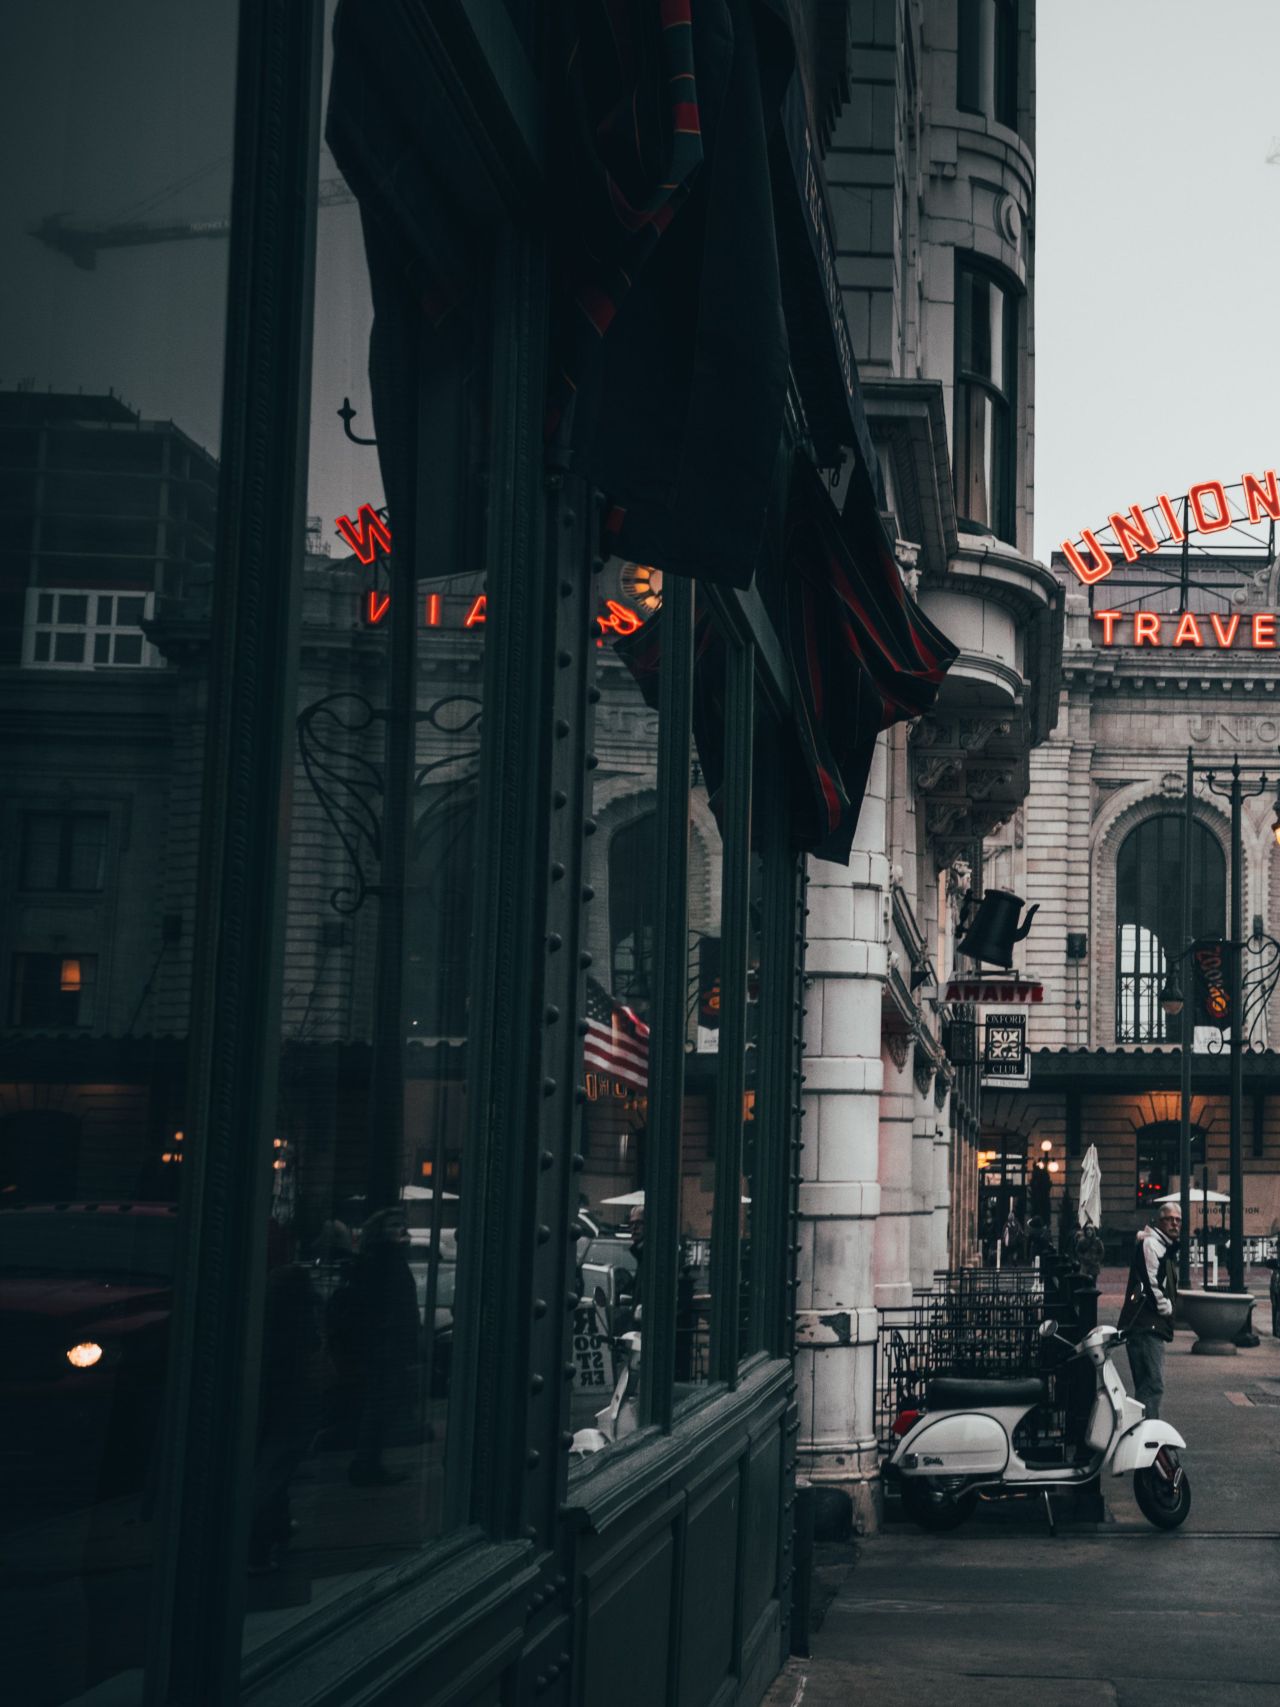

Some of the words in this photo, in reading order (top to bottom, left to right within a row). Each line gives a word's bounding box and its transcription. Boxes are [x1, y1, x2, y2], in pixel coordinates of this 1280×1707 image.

[944, 984, 1044, 1002] AMANTE
[986, 1014, 1027, 1025] OXFORD
[991, 1063, 1018, 1075] CLUB
